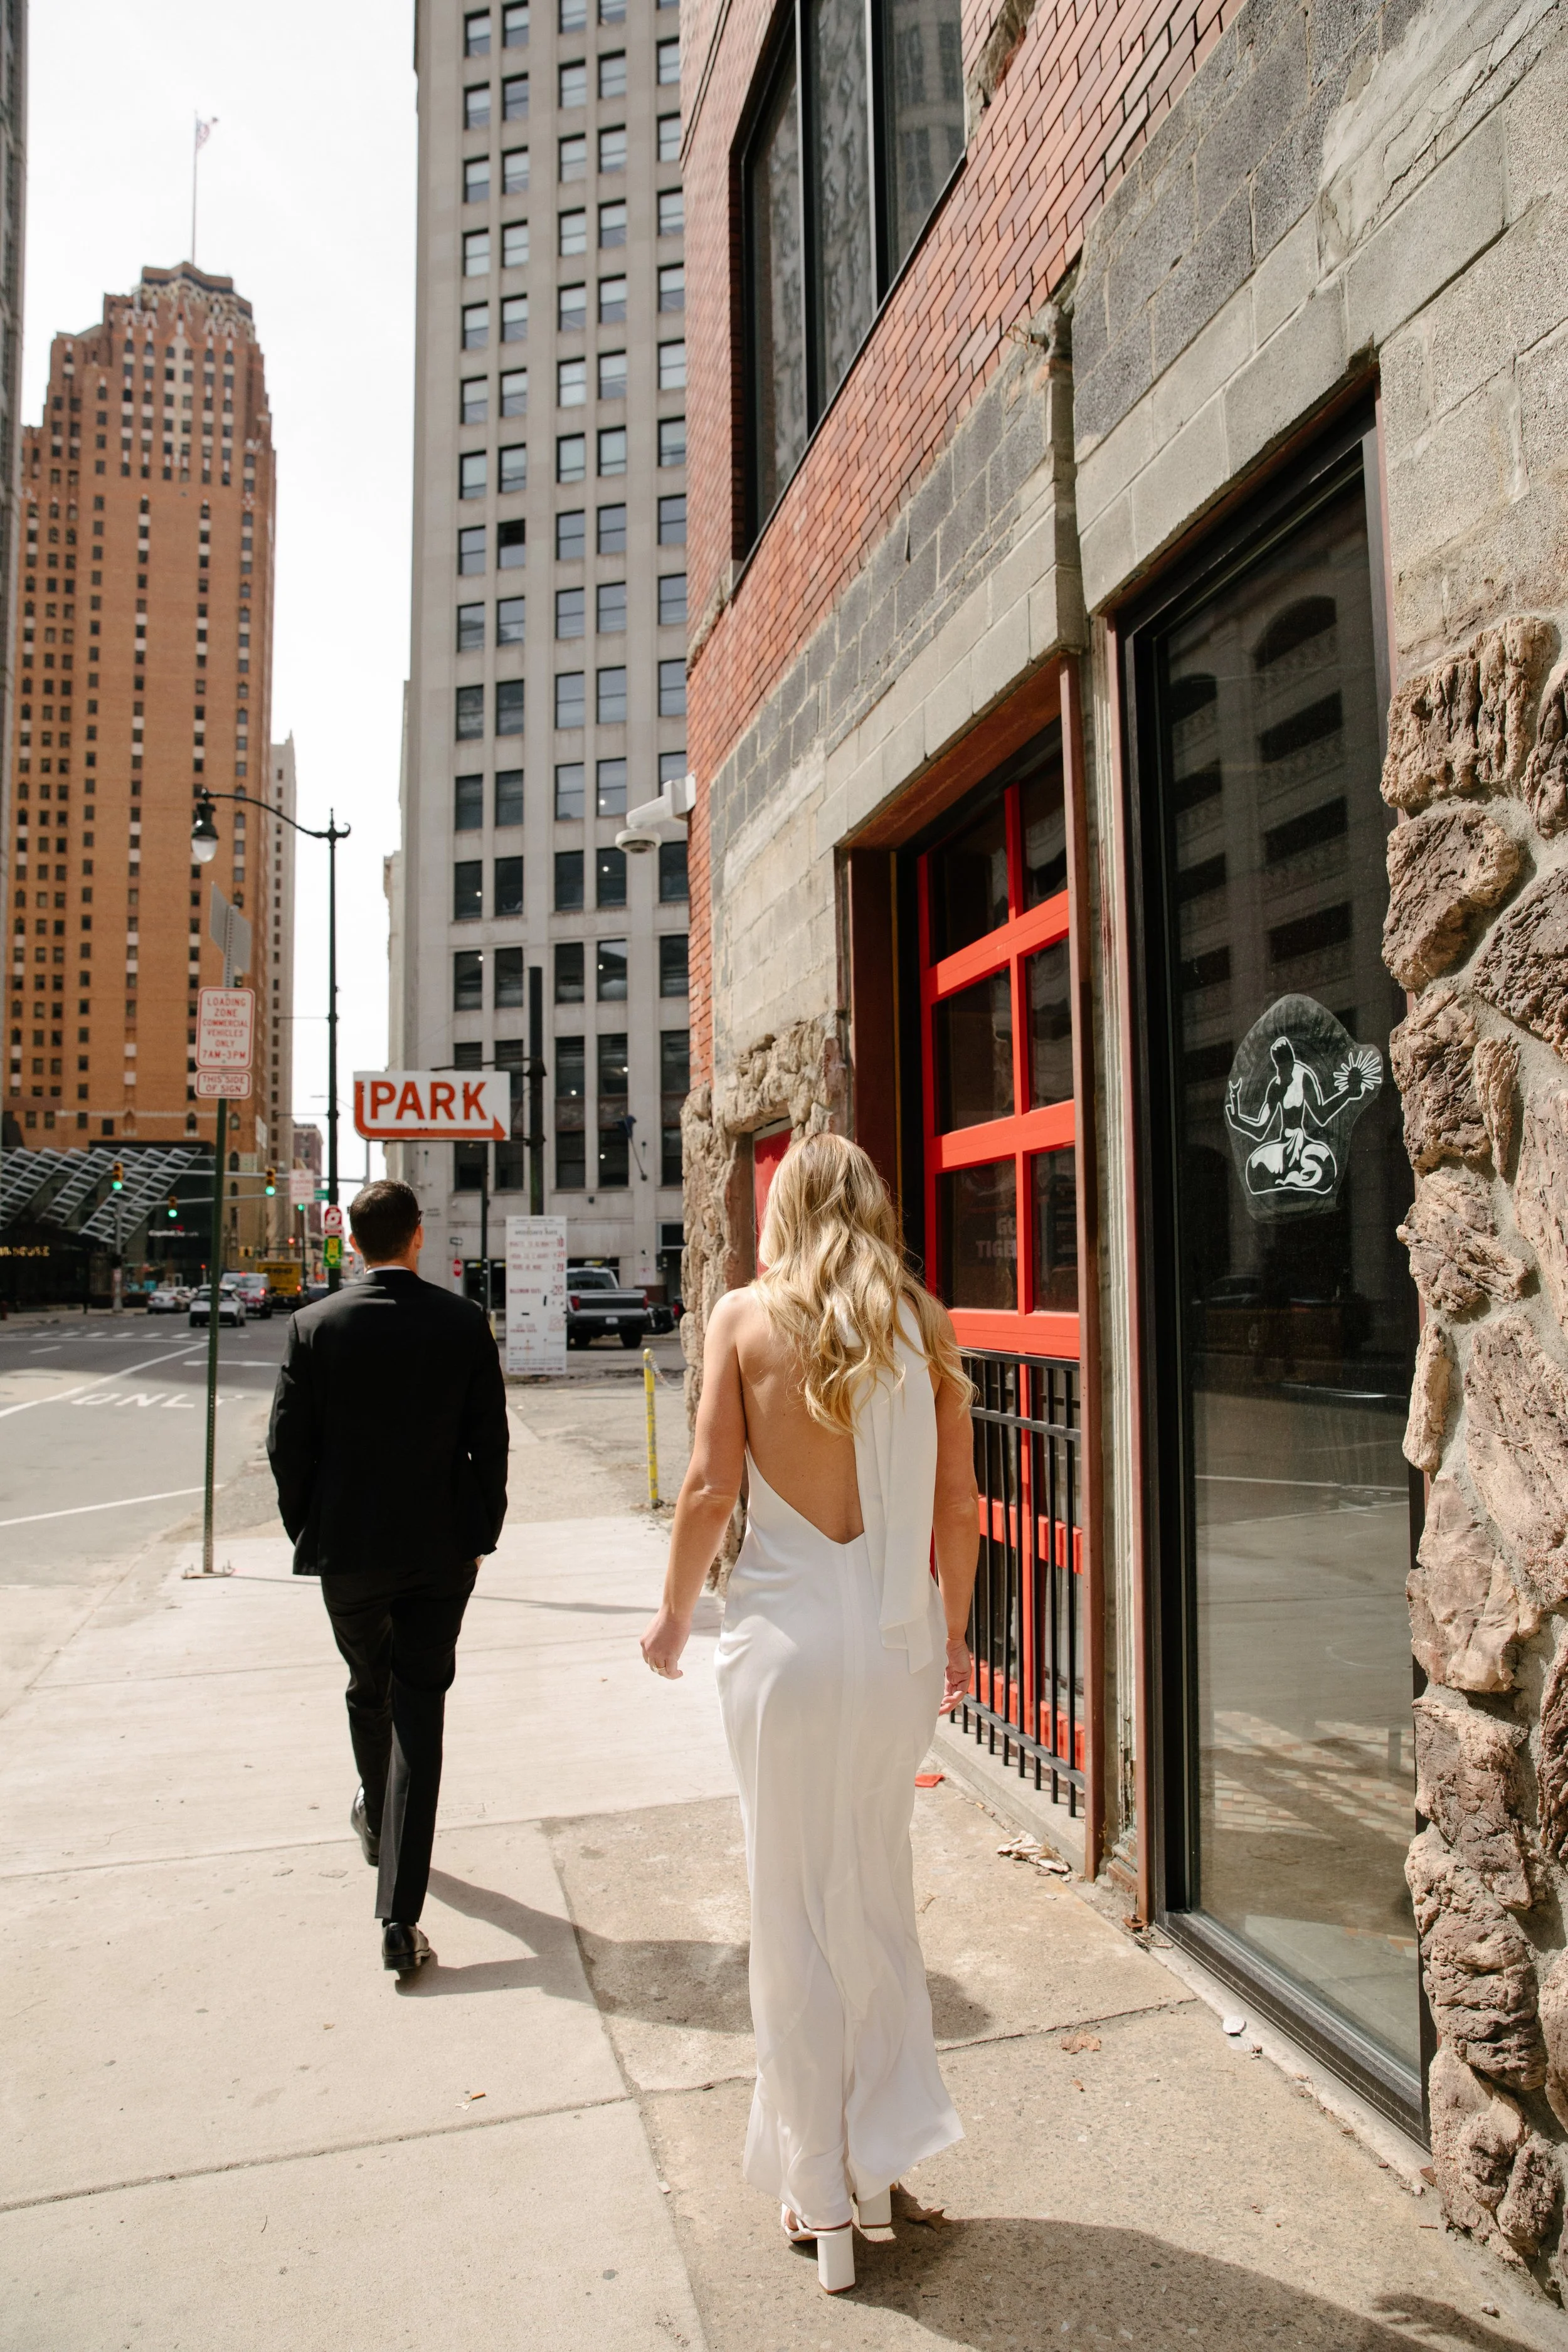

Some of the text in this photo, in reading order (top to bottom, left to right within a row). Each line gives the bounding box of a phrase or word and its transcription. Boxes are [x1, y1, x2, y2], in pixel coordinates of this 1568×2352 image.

[207, 997, 246, 1007] LOADING
[214, 1008, 237, 1017] ZONE
[203, 1019, 248, 1028] COMMERCIAL
[207, 1029, 243, 1037] VEHICLES
[215, 1039, 235, 1047] ONLY
[203, 1075, 244, 1084] THIS SIDE
[370, 1081, 487, 1120] PARK
